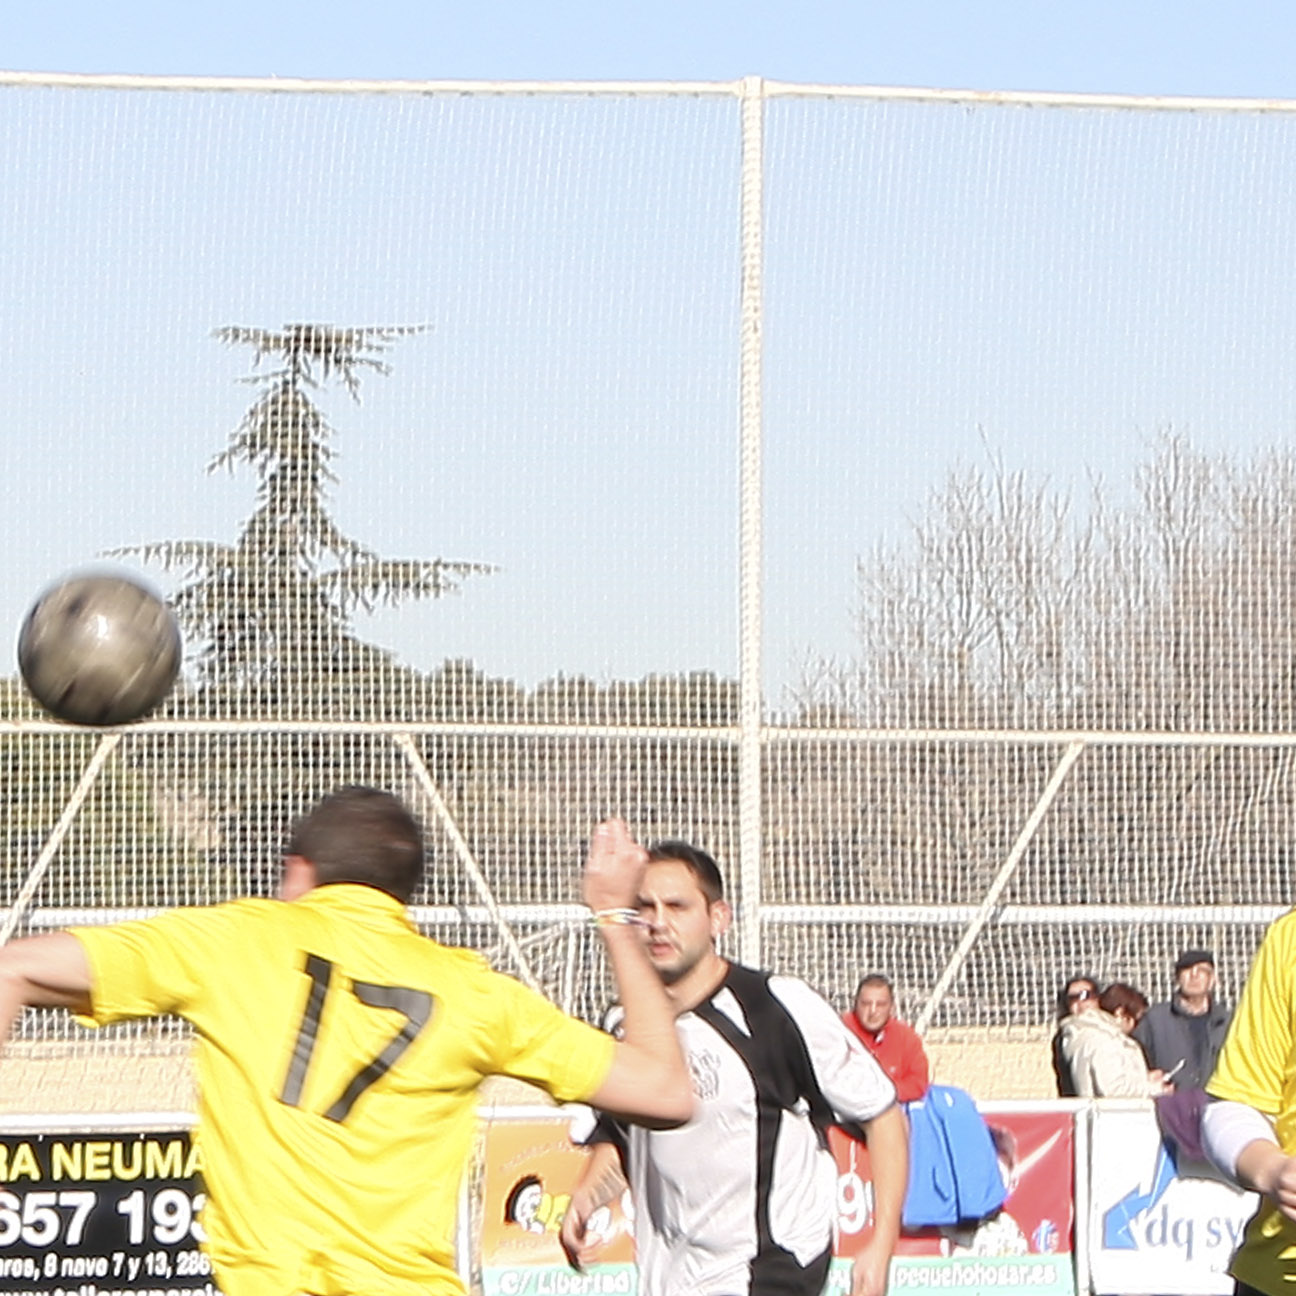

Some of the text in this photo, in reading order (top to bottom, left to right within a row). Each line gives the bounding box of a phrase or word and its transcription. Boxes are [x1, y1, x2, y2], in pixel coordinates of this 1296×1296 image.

[279, 951, 436, 1124] 17
[1144, 1203, 1194, 1262] dq
[127, 1257, 141, 1282] y
[176, 1250, 217, 1276] 286
[536, 1269, 631, 1296] Libertad
